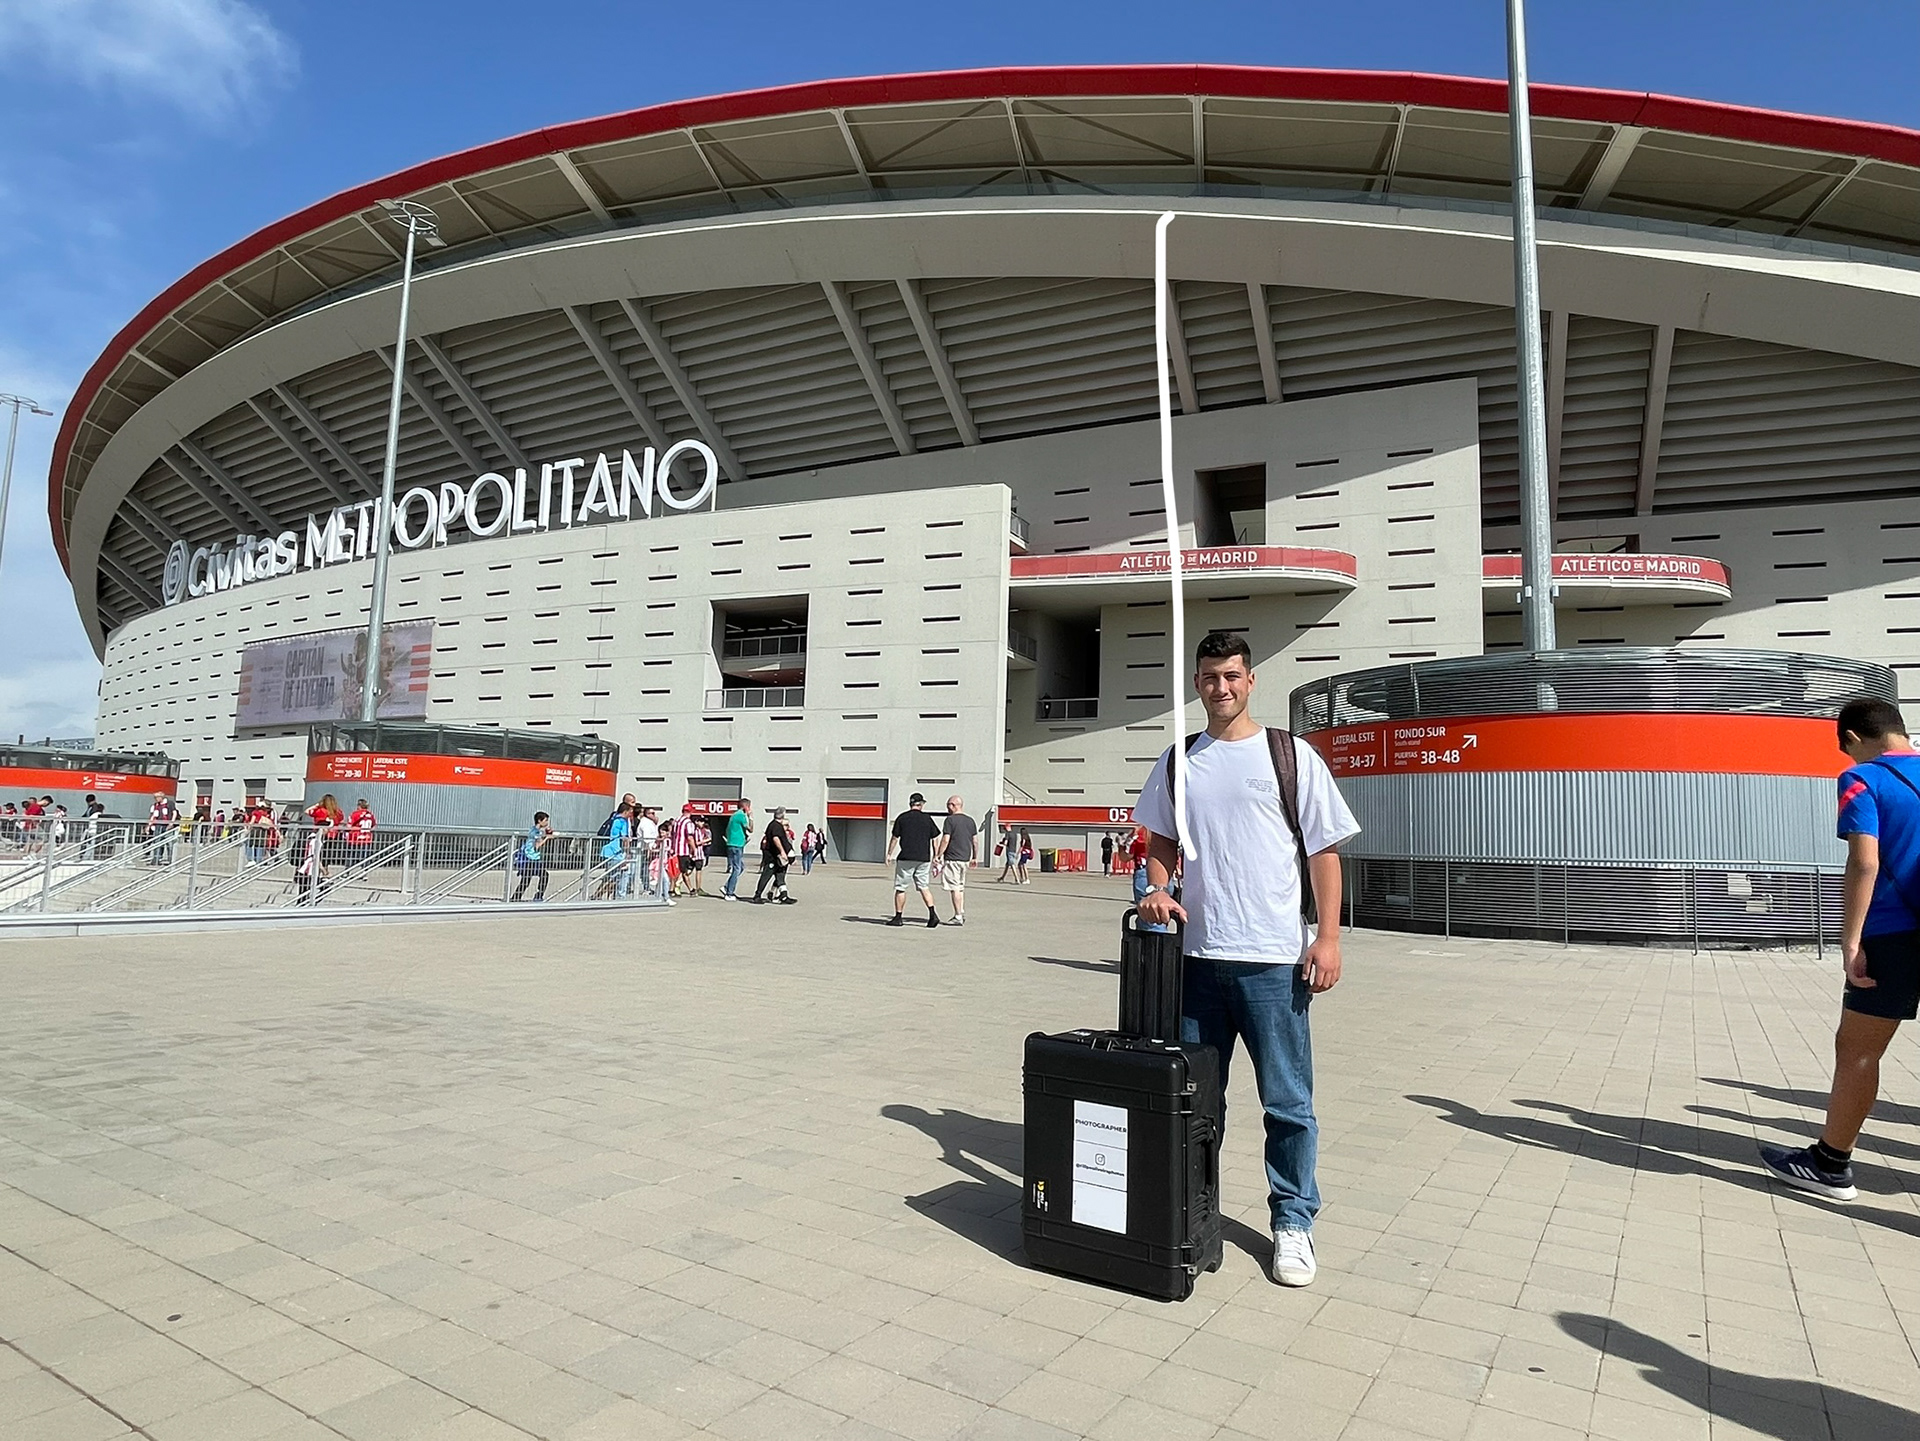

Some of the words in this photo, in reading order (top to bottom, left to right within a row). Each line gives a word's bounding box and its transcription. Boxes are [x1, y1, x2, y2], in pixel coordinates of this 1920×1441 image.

[1199, 551, 1258, 565] MADRID
[1560, 557, 1632, 572] ATLÉTICO
[1646, 560, 1700, 574] MADRID
[1332, 733, 1358, 746] LATERAL
[1358, 731, 1375, 743] ESTE
[1394, 728, 1425, 739] FONDO
[1426, 726, 1446, 737] SUR
[1349, 754, 1376, 769] 34-37
[1420, 749, 1460, 765] 38-48
[709, 801, 723, 814] 06
[1109, 808, 1128, 822] 05
